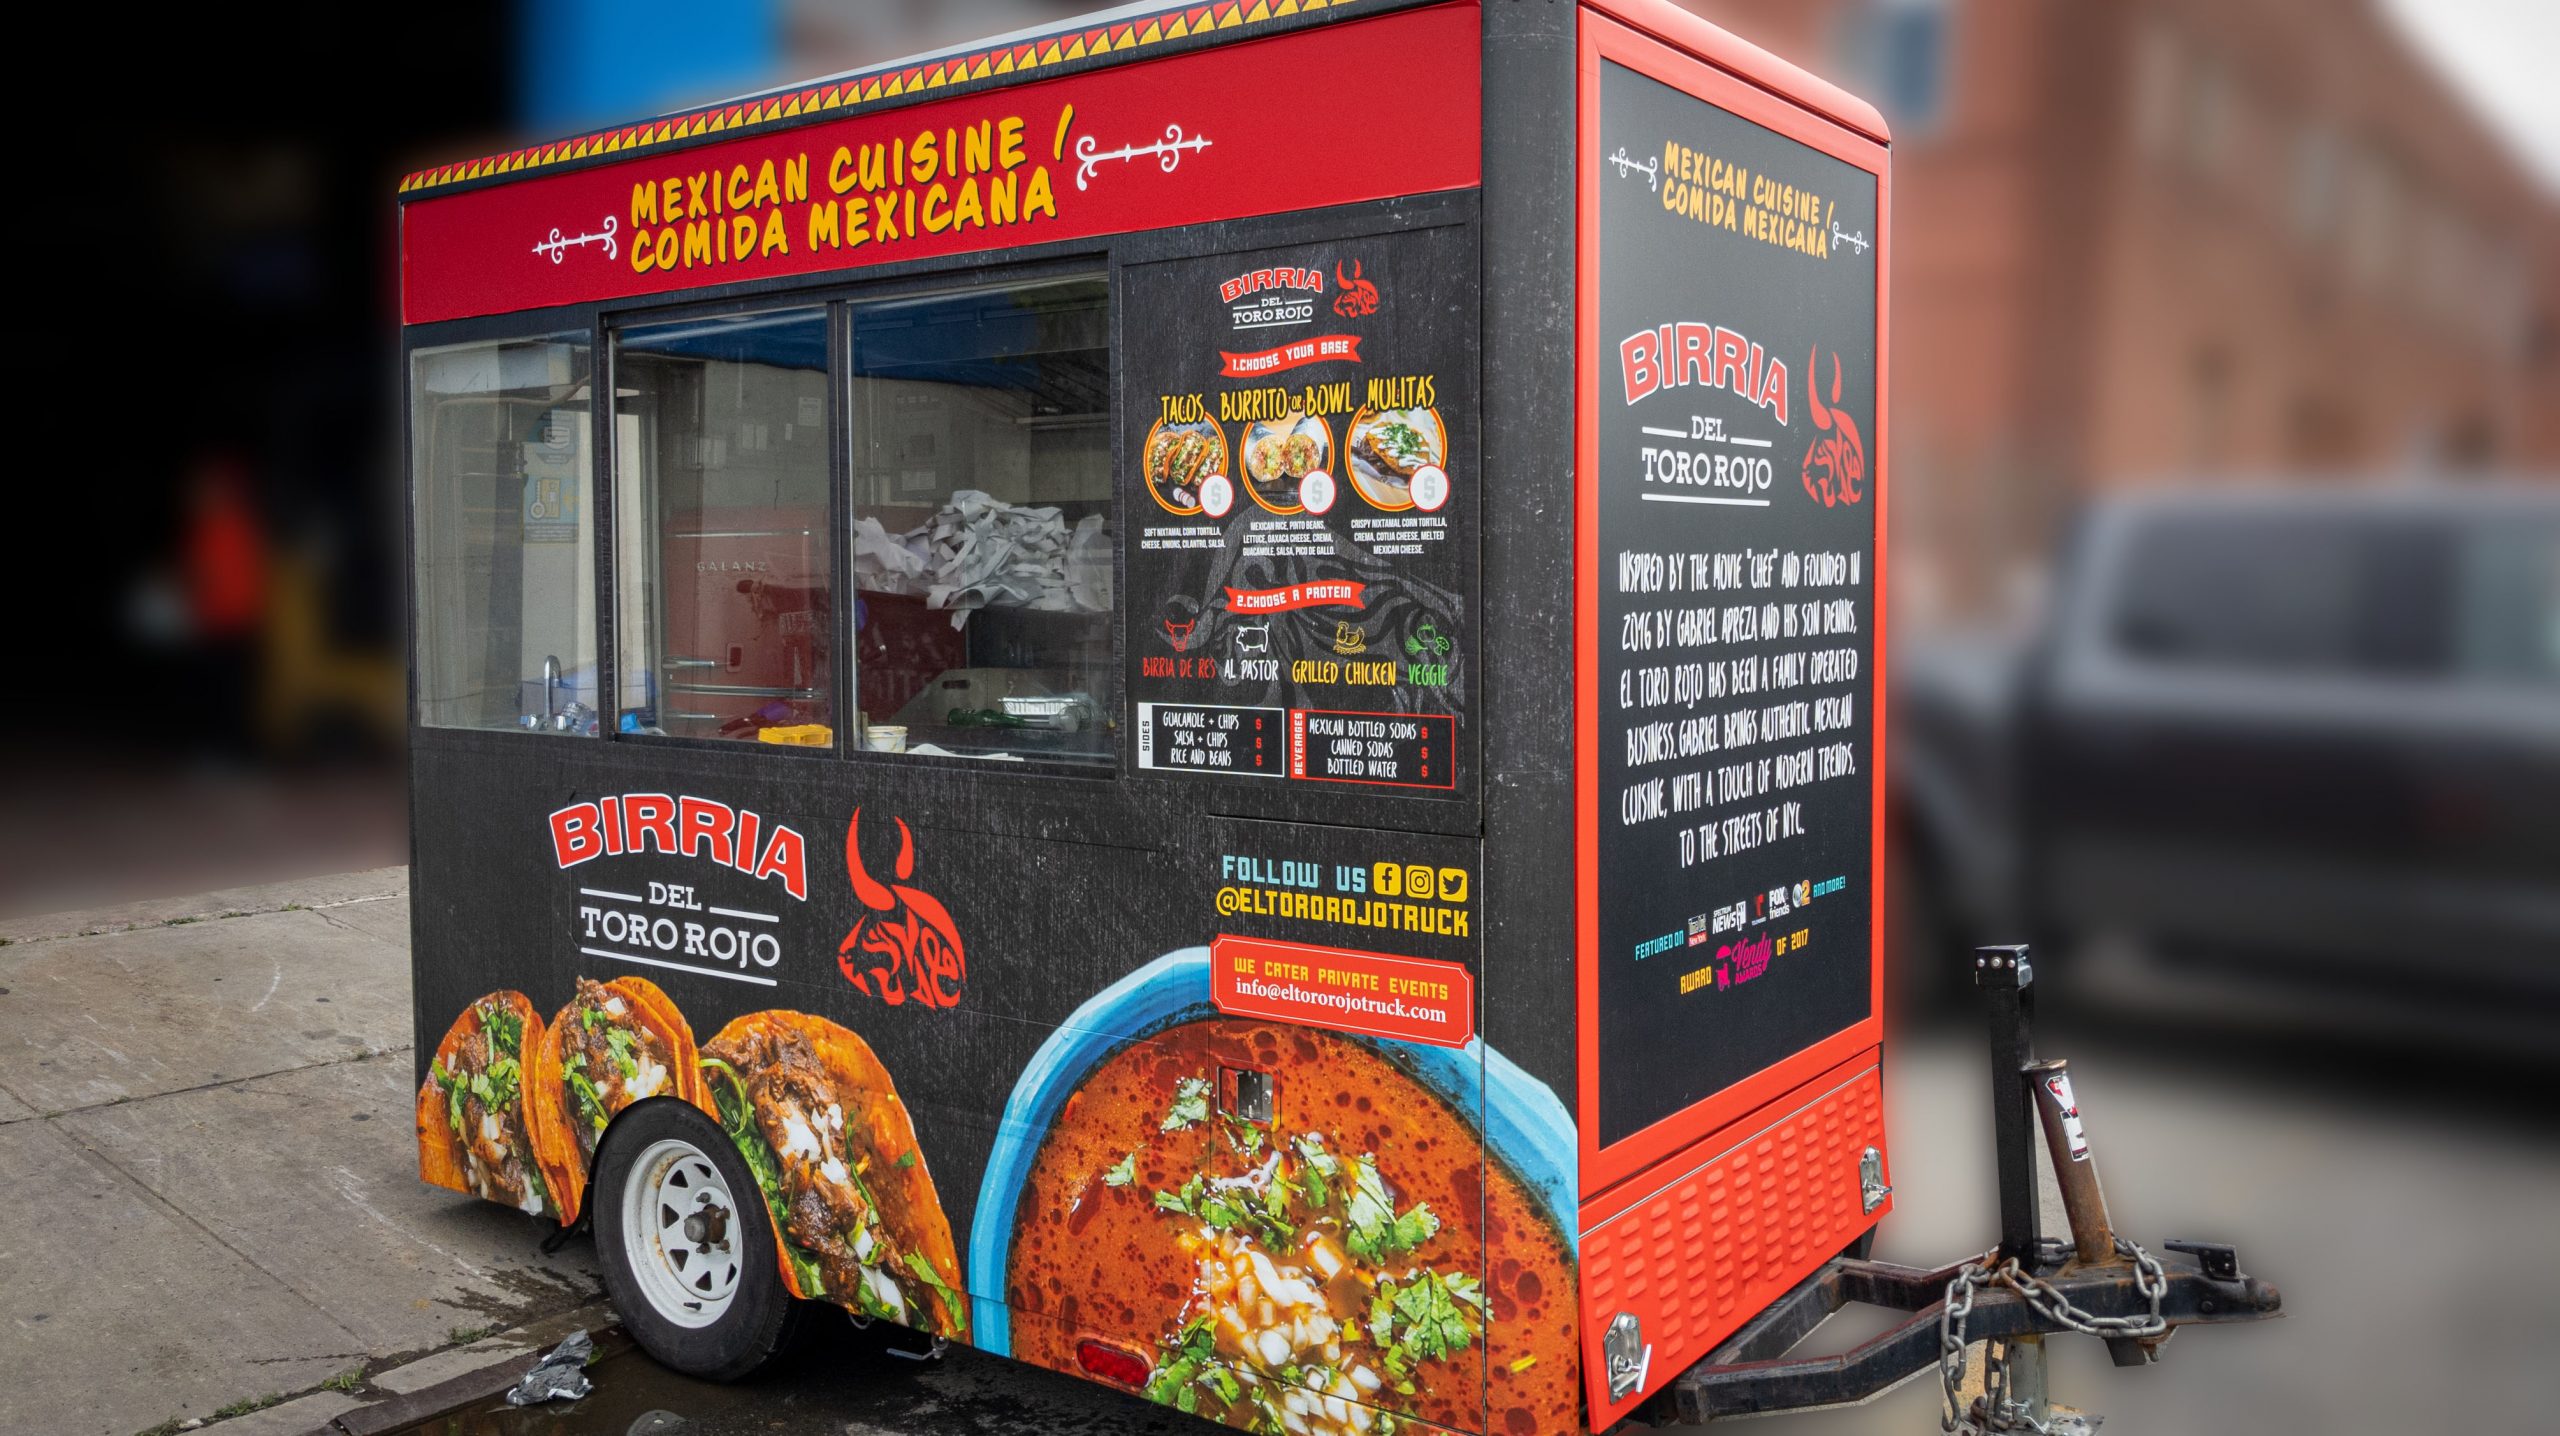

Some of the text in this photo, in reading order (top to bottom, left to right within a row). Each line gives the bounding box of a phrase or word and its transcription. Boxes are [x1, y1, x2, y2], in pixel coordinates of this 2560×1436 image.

[631, 152, 809, 229] MEXICAN
[828, 116, 1028, 195] CUISINE
[1664, 140, 1747, 200] MEXICAN
[1753, 174, 1820, 226] CUISINE
[630, 165, 1058, 274] COMIDA MEXICANA
[1662, 177, 1828, 260] COMIDA MEXICANA
[1219, 267, 1324, 303] BIRRIA
[1233, 306, 1313, 324] TORO ROJO
[1261, 297, 1283, 307] DEL
[1232, 341, 1349, 371] 1.CHOOSE YOUR BASE
[1619, 321, 1788, 427] BIRRIA
[1220, 387, 1289, 422] BURRITO
[1305, 382, 1354, 416] BOWL
[1367, 375, 1435, 411] MULITAS
[1161, 393, 1205, 424] TACOS
[1691, 415, 1727, 442] DEL
[1641, 447, 1772, 494] TORO ROJO
[697, 560, 767, 572] GALANZ
[1619, 550, 1664, 593] INSPIRED
[1669, 552, 1685, 592] BY
[1690, 553, 1709, 592] THE
[1713, 552, 1742, 591] MOVIE
[1781, 551, 1800, 588] AND
[1804, 550, 1847, 587] FOUNDED
[1851, 550, 1861, 586] IN
[1236, 586, 1351, 608] 2.CHOOSE A PROTEIN
[1622, 611, 1652, 652] 2016
[1657, 608, 1673, 649] BY
[1677, 606, 1718, 648] GABRIEL
[1721, 605, 1758, 645] APREZA
[1761, 602, 1780, 641] AND
[1783, 603, 1798, 638] HIS
[1801, 599, 1820, 637] SON
[1142, 657, 1217, 679] BIRRIA DE RES
[1224, 659, 1279, 681] AL PASTOR
[1292, 660, 1397, 686] GRILLED CHICKEN
[1407, 663, 1449, 686] VEGGIE
[1620, 647, 1858, 710] EL TORO ROJO HAS BEEN A FAMILY OPERATED
[1162, 711, 1240, 730] GUACAMOLE CHIPS
[1309, 718, 1417, 740] MEXICAN BOTTLED SODAS
[1679, 714, 1719, 758] GABRIEL
[1724, 708, 1758, 750] BRINGS
[1761, 700, 1811, 743] AUTHENTIC
[1814, 692, 1853, 733] MEXICAN
[1142, 720, 1150, 752] SIDES
[1174, 730, 1228, 748] SALSA CHIPS
[1294, 712, 1303, 775] BEVERAGES
[1331, 738, 1394, 758] CANNED SODAS
[1170, 748, 1232, 767] RICE AND BEANS
[1327, 758, 1398, 779] BOTTLED WATER
[1673, 771, 1701, 813] WITH
[1706, 771, 1713, 807] A
[1718, 761, 1753, 805] TOUCH
[1758, 758, 1771, 795] OF
[1776, 746, 1814, 790] MODERN
[549, 793, 808, 902] BIRRIA
[1679, 829, 1695, 869] TO
[1700, 821, 1718, 863] THE
[1722, 811, 1762, 856] STREETS
[1766, 806, 1779, 844] OF
[1222, 855, 1366, 893] FOLLOW US
[648, 881, 702, 911] DEL
[1768, 886, 1786, 908] FOX
[1802, 879, 1811, 906] 2
[1813, 884, 1826, 898] AND
[1215, 886, 1469, 938] @ELTOROROJOTRUCK
[1713, 911, 1737, 935] NEWS
[1769, 904, 1790, 920] friends
[580, 906, 781, 969] TORO ROJO
[1635, 929, 1684, 961] FEATURED ON
[1776, 928, 1809, 957] OF 2017
[1234, 956, 1449, 1001] WE CATER PRIVATE EVENTS
[1680, 966, 1712, 995] AWARD
[1734, 963, 1764, 985] AWARDS
[1235, 977, 1447, 1023] info@eltororojotruck.com
